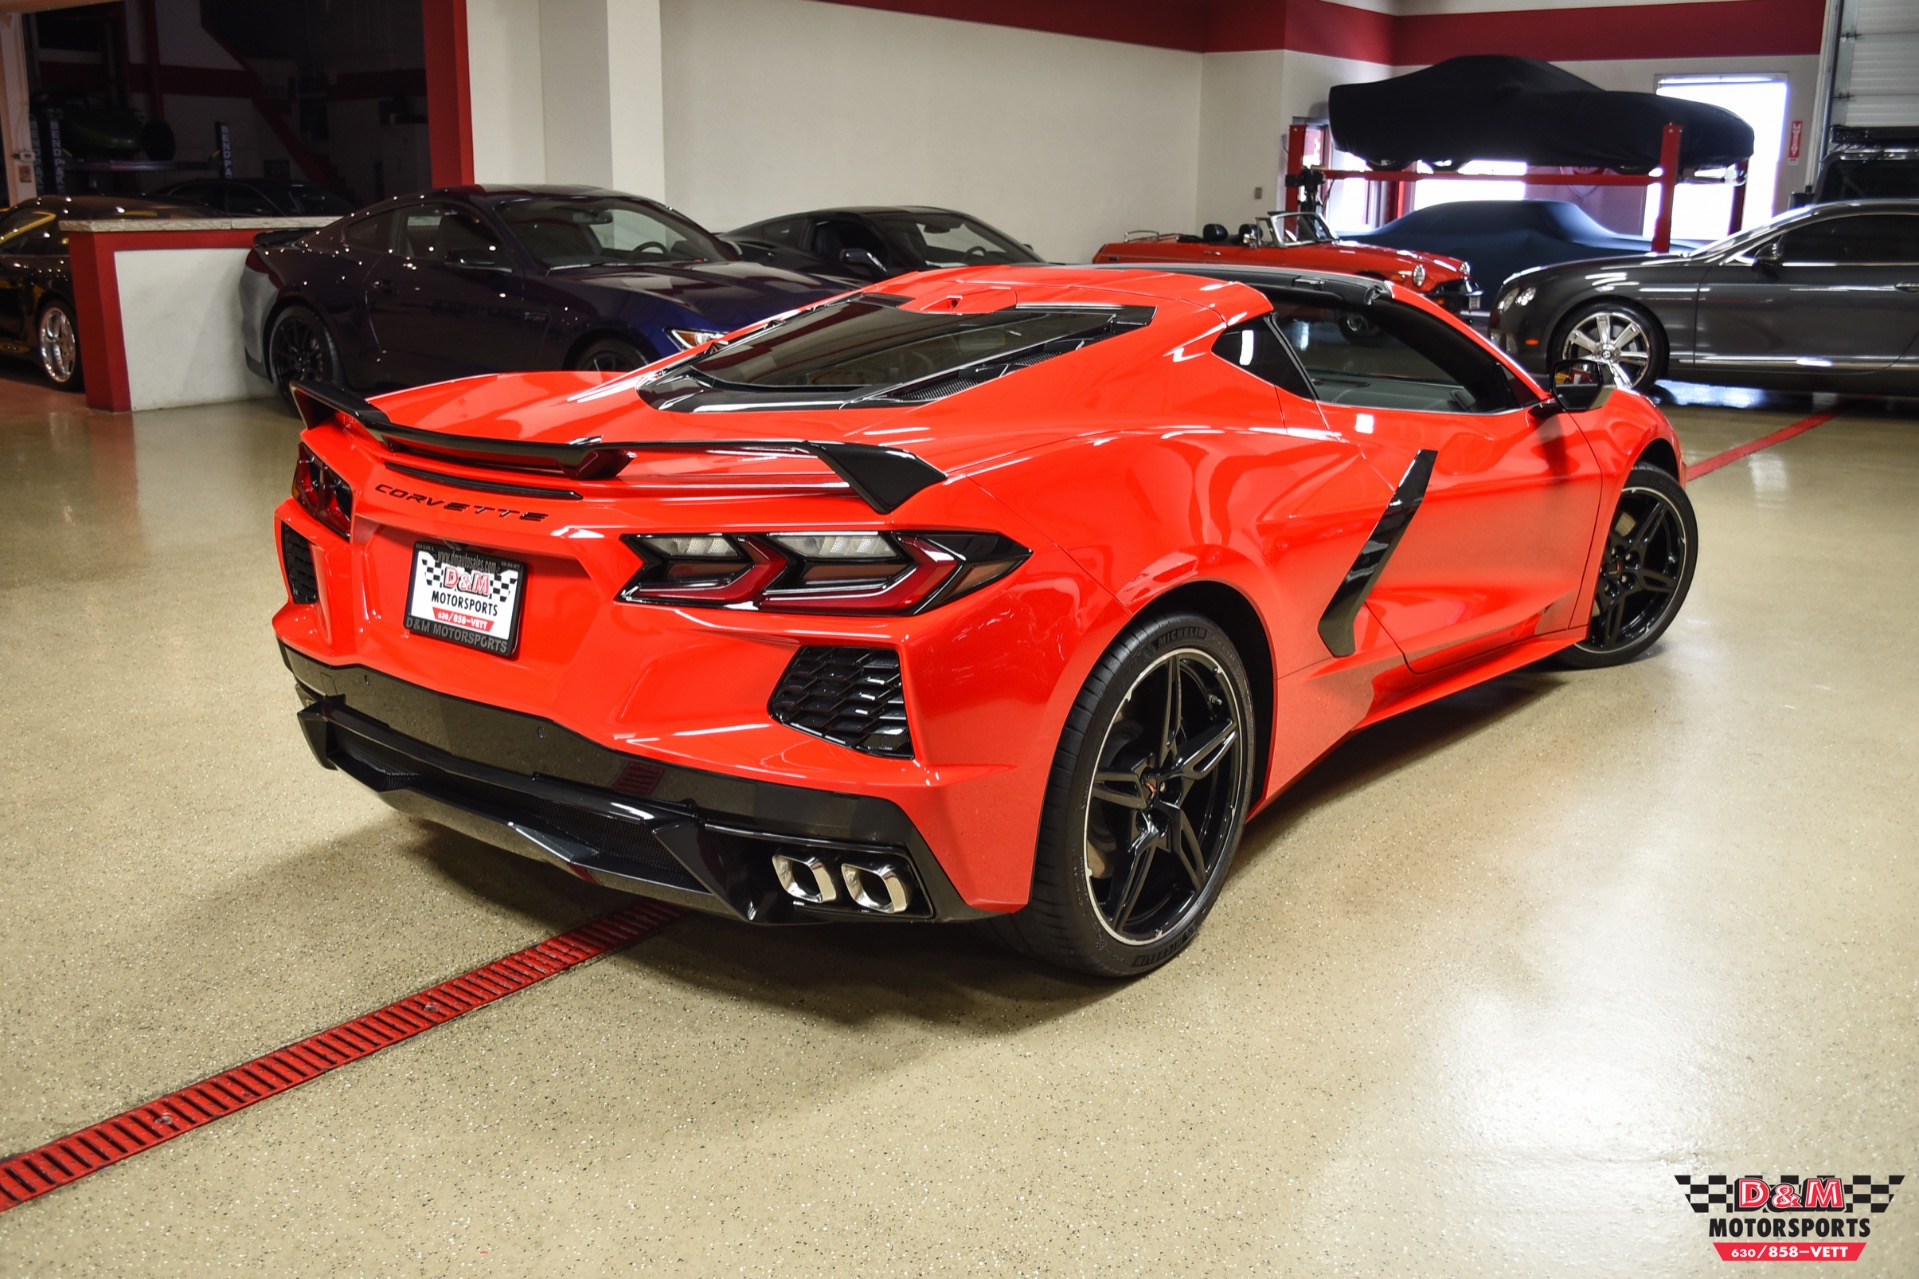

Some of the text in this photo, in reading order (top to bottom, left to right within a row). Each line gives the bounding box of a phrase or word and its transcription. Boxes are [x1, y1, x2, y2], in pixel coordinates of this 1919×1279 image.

[375, 483, 549, 522] CORVETTE
[444, 565, 490, 597] D&M
[431, 590, 498, 617] MOTORSPORTS
[405, 617, 508, 653] D&M MOTORSPORTS
[437, 611, 488, 630] 630/858-VETT
[1158, 627, 1206, 646] MICHELIN
